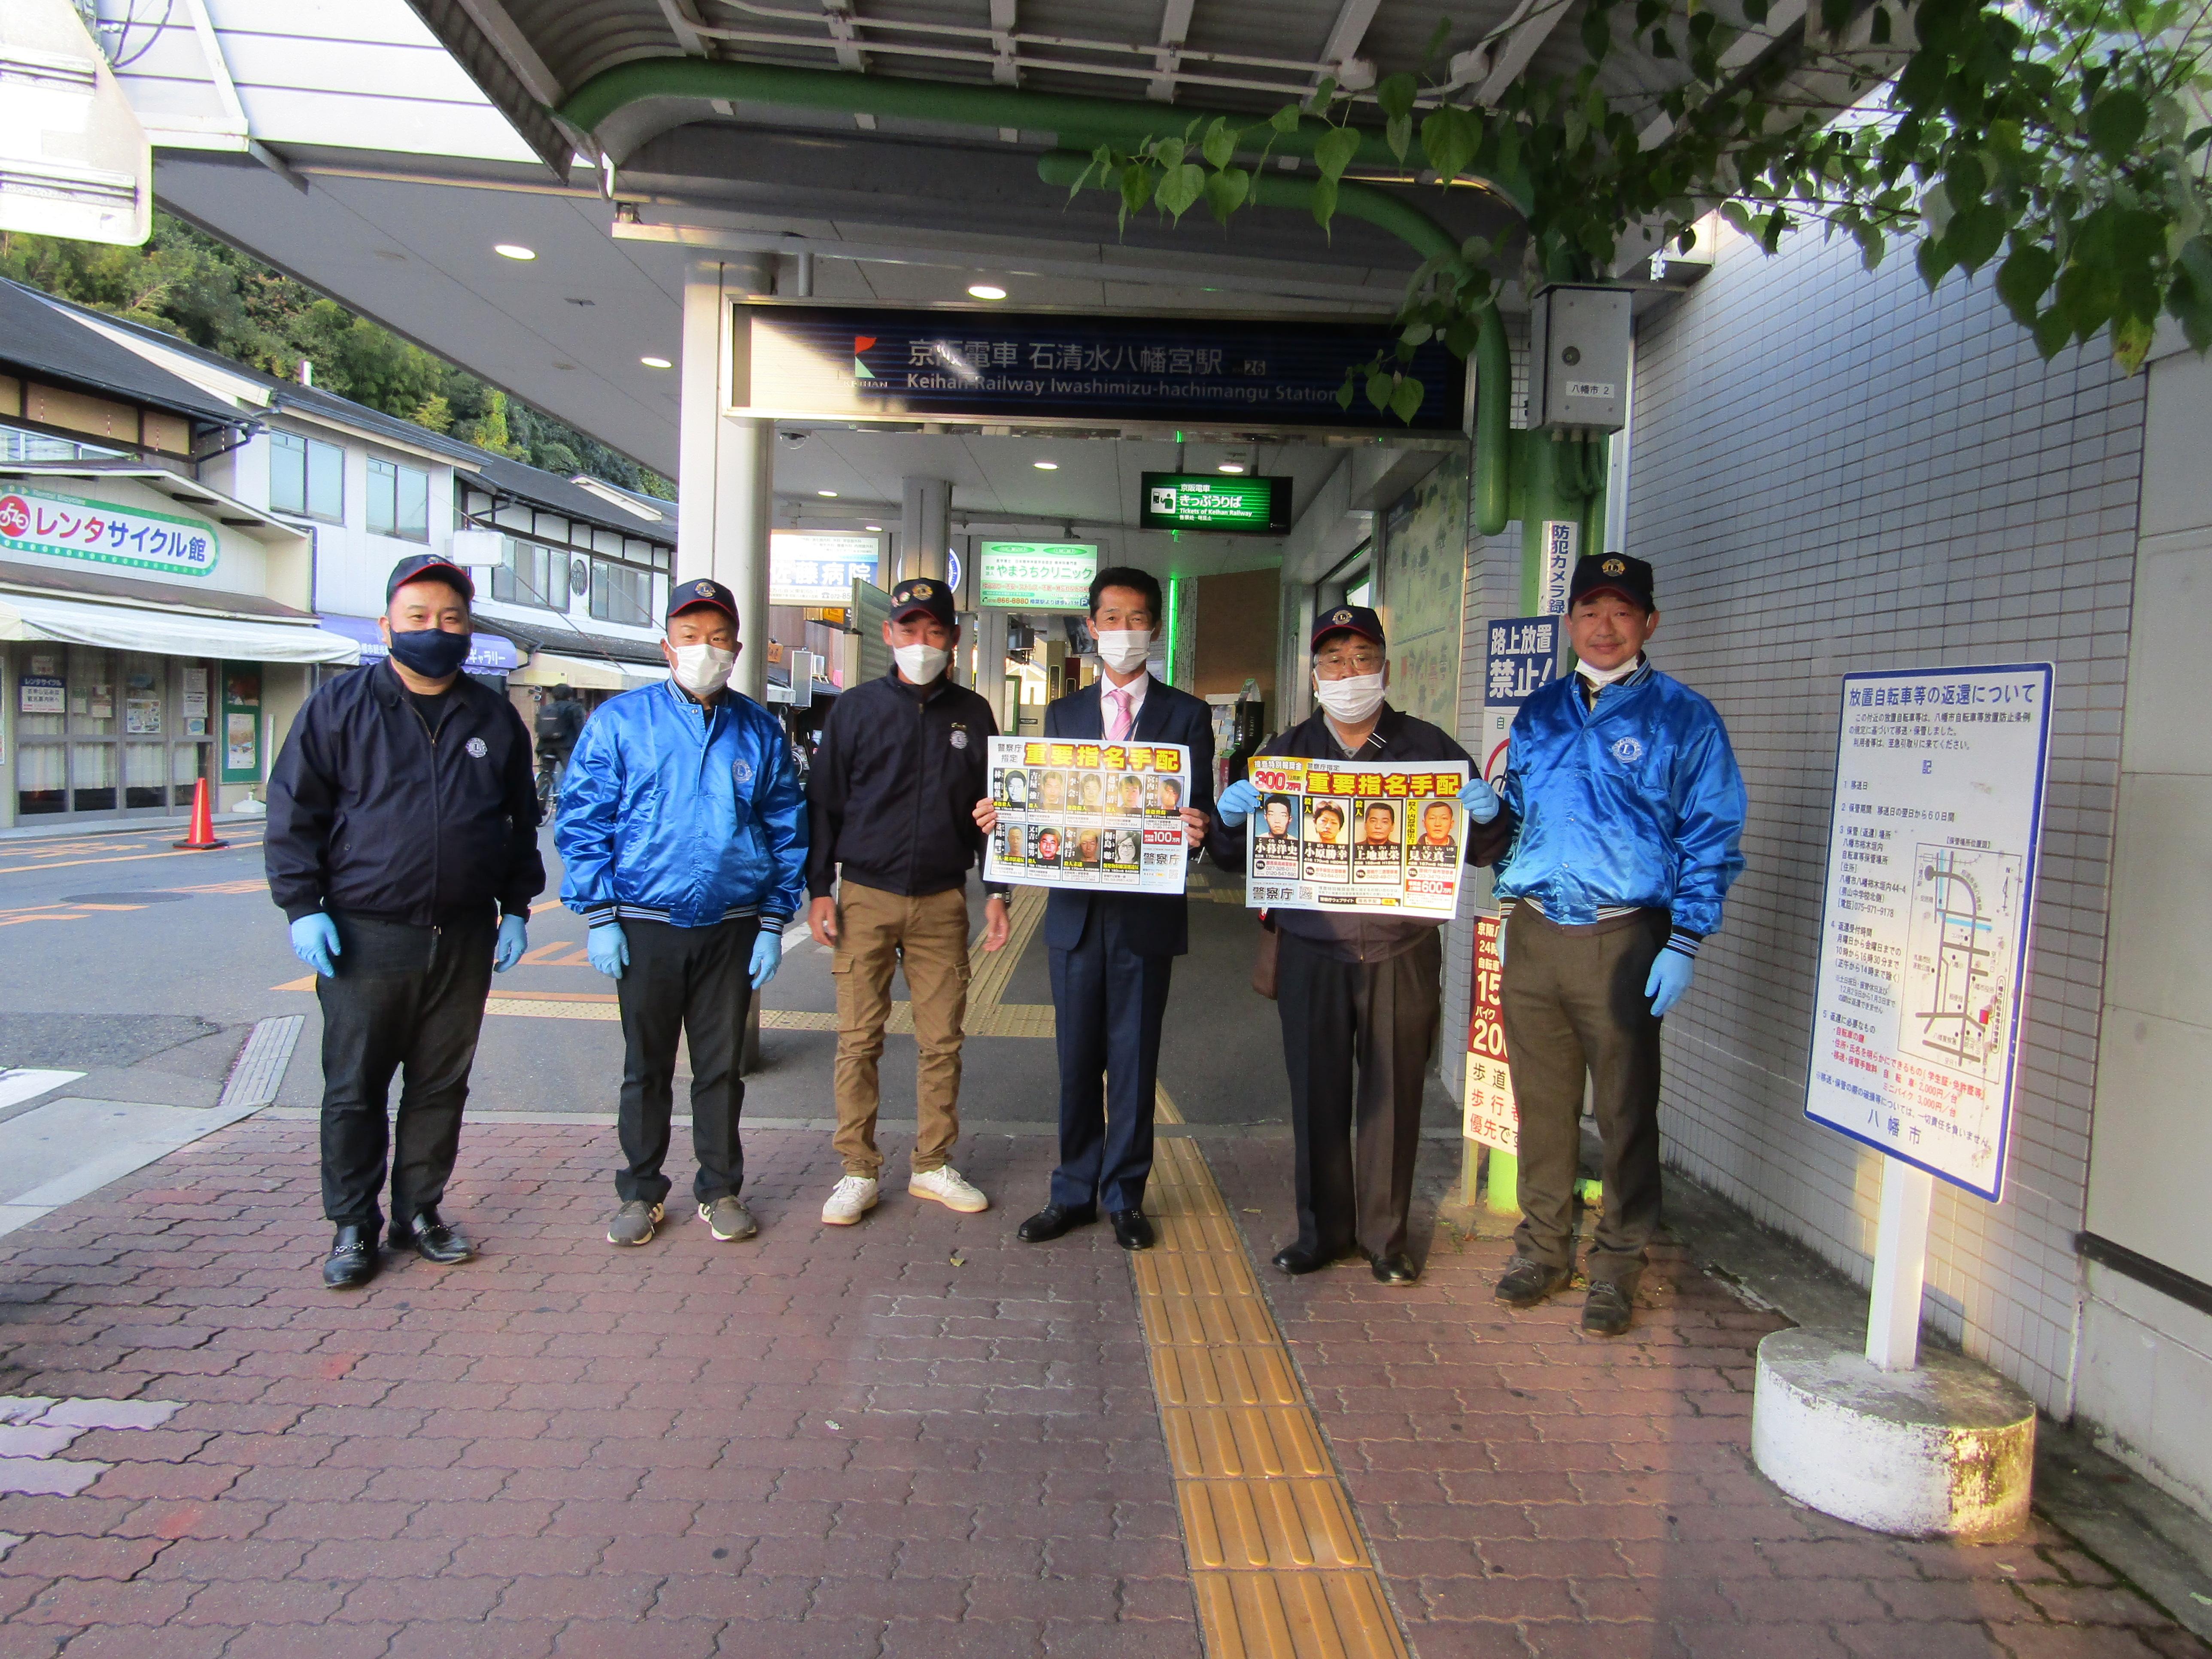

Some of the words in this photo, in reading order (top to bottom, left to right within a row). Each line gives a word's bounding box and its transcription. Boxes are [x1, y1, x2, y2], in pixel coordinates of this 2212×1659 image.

[1029, 342, 1222, 375] 石清水八幡宮駅
[907, 373, 968, 390] Keihan
[975, 375, 1045, 396] Railway
[1051, 378, 1269, 403] Iwashimizu-hachimangu
[1276, 385, 1338, 401] Station
[1571, 384, 1599, 394] 八幡市
[1604, 386, 1609, 395] 2
[1180, 484, 1211, 492] 京阪電車
[1179, 495, 1243, 508] きっぷうりば
[36, 507, 207, 562] レンタサイクル館
[997, 565, 1093, 580] やまうちクリニック
[1491, 625, 1552, 656] 路上放置
[1849, 684, 2036, 707] 放置自転車等の返還について
[998, 743, 1022, 752] 警察庁
[1623, 744, 1630, 754] L
[1001, 754, 1017, 763] 指定
[1024, 743, 1181, 772] 重要指名手配
[1254, 760, 1303, 771] 捜査特別報奨金
[1307, 763, 1340, 771] 警察庁指定
[1922, 760, 1932, 774] 記
[1255, 771, 1286, 790] 300
[1286, 782, 1301, 791] 万円
[1305, 771, 1462, 798] 重要指名手配
[1851, 780, 1868, 790] 移送日
[1304, 797, 1312, 814] 殺人
[1355, 800, 1363, 817] 殺人
[1841, 803, 1846, 811] 2
[1849, 803, 1872, 815] 保管期間
[1154, 831, 1172, 843] 100
[1840, 826, 1844, 834] 3
[1255, 842, 1298, 855] 小暮洋史
[1408, 850, 1455, 862] 見立真一
[1143, 853, 1182, 865] 警察庁
[1842, 850, 1889, 866] 自転車等保管場所
[1252, 887, 1294, 901] 警察庁
[1422, 881, 1443, 893] 600
[1838, 921, 1873, 938] 返還受付時間
[1837, 933, 1902, 957] 月曜日から金曜日までの
[1478, 957, 1500, 972] 自転車
[1836, 946, 1899, 969] 10時から16時30分まで
[1475, 1006, 1495, 1021] バイク
[1830, 1012, 1876, 1035] 返還に必要なもの
[1473, 1019, 1508, 1058] 20
[1883, 1082, 1914, 1101] ミニバイク
[1867, 1108, 1922, 1146] 八幡市
